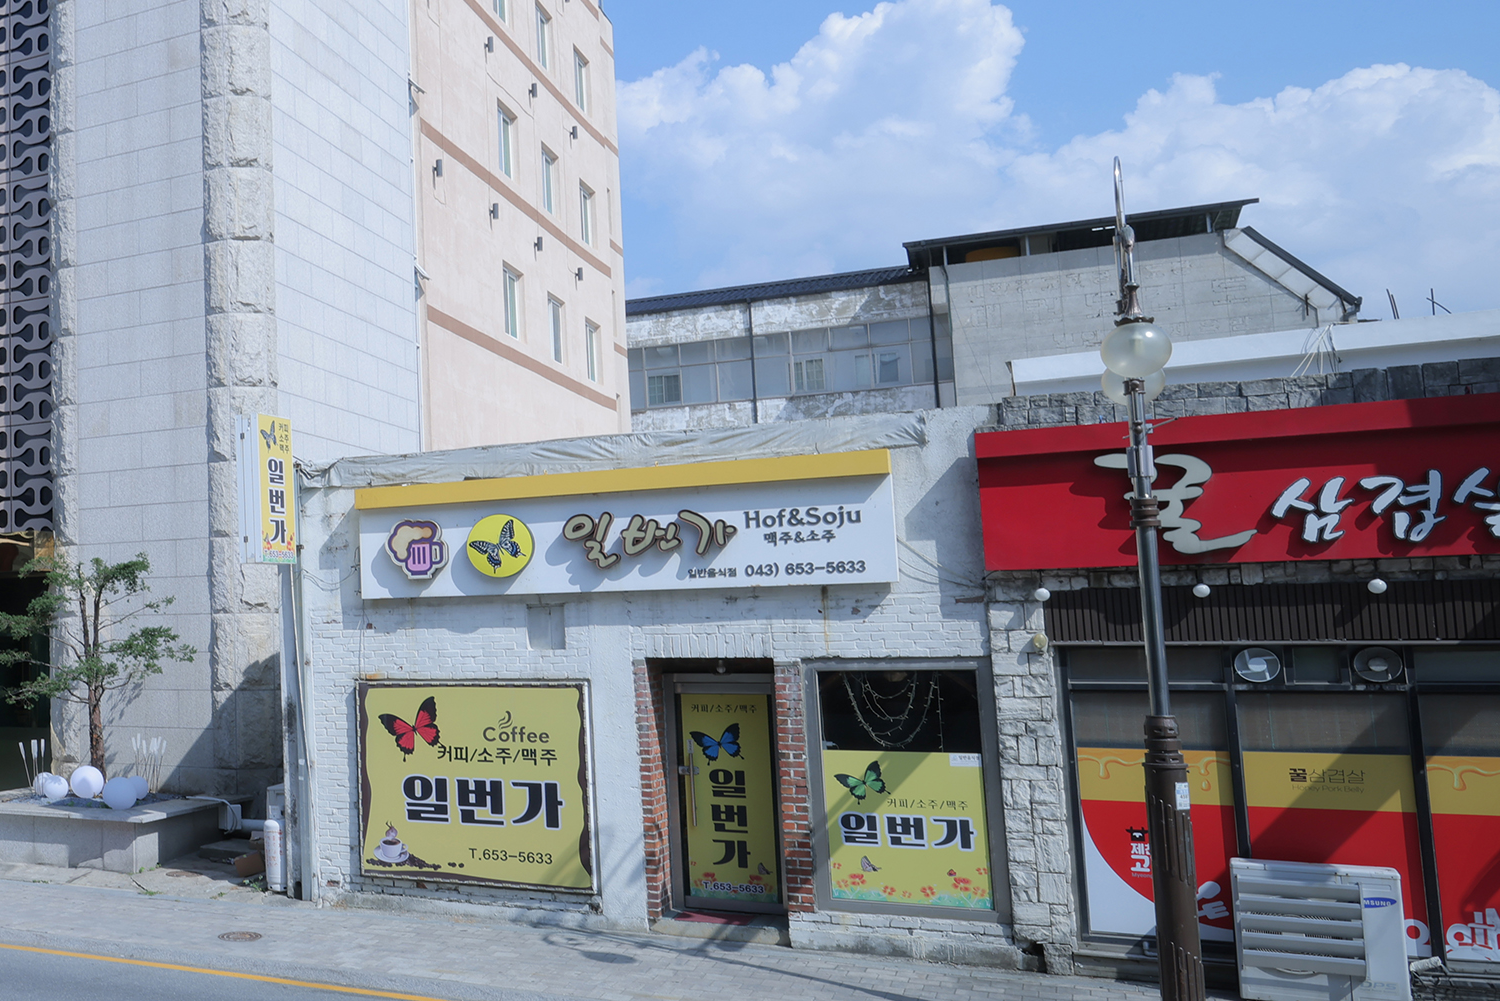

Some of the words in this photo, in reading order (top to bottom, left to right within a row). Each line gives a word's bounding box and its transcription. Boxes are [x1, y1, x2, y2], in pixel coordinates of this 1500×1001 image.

[268, 459, 287, 544] 일번가
[744, 506, 862, 529] Hof&Soju
[562, 510, 738, 569] 일번가
[763, 529, 836, 547] 맥주&소주
[687, 567, 738, 579] 일반음식점
[745, 564, 779, 578] 043)
[785, 560, 867, 576] 653-5633
[482, 726, 550, 743] Coffee
[437, 746, 558, 767] 커피/소주/맥주
[1289, 768, 1365, 784] 꿀삼겹살
[403, 776, 564, 829] 일번가
[887, 799, 968, 811] 커피/소주/맥주
[709, 769, 751, 869] 일번가
[840, 813, 974, 850] 일번가
[468, 848, 553, 864] T.653-5633
[703, 880, 765, 893] T.653-5633
